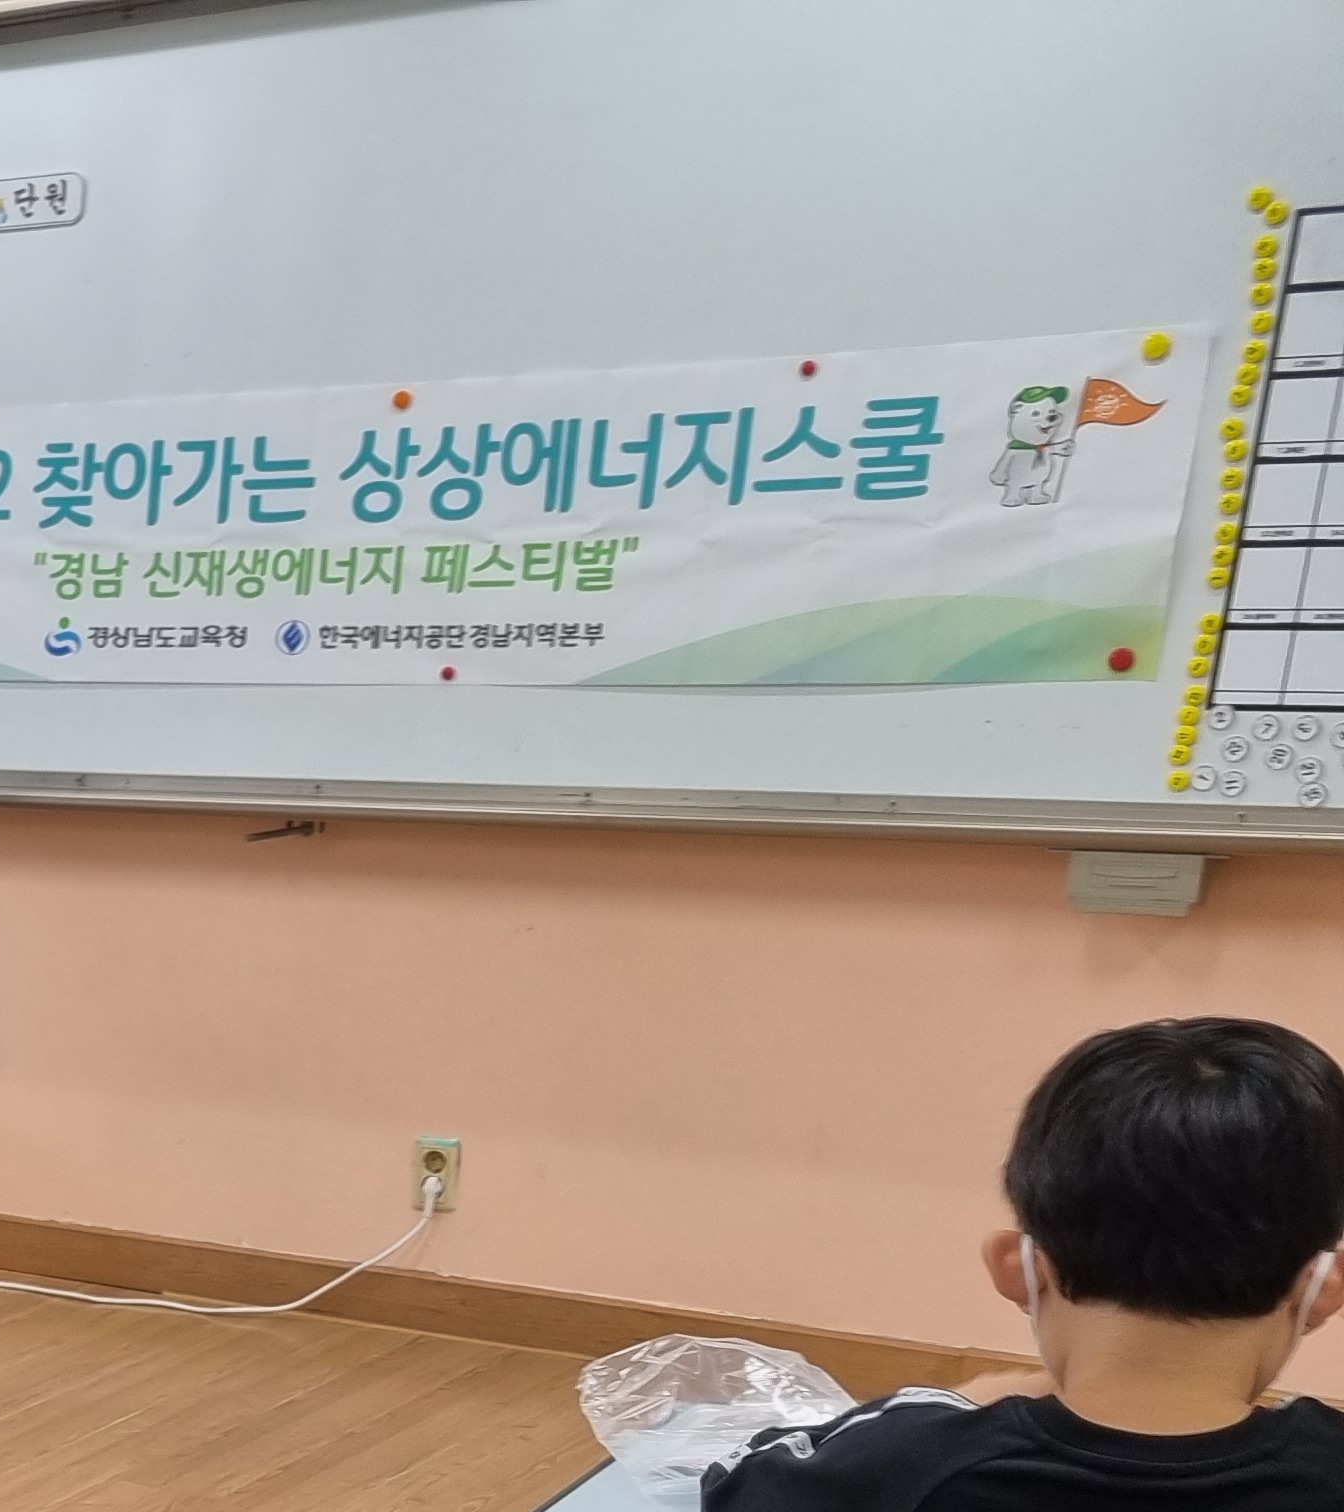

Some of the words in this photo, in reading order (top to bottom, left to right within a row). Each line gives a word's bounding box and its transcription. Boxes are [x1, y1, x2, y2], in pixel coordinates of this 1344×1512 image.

[13, 179, 68, 218] 단원
[34, 435, 317, 530] 찾아가는
[338, 393, 946, 527] 상상에너지스쿨
[32, 549, 131, 603] "경남
[141, 541, 405, 601] 신재생에너지
[420, 535, 640, 599] 페스티벌"
[88, 624, 248, 650] 경상남도교육청
